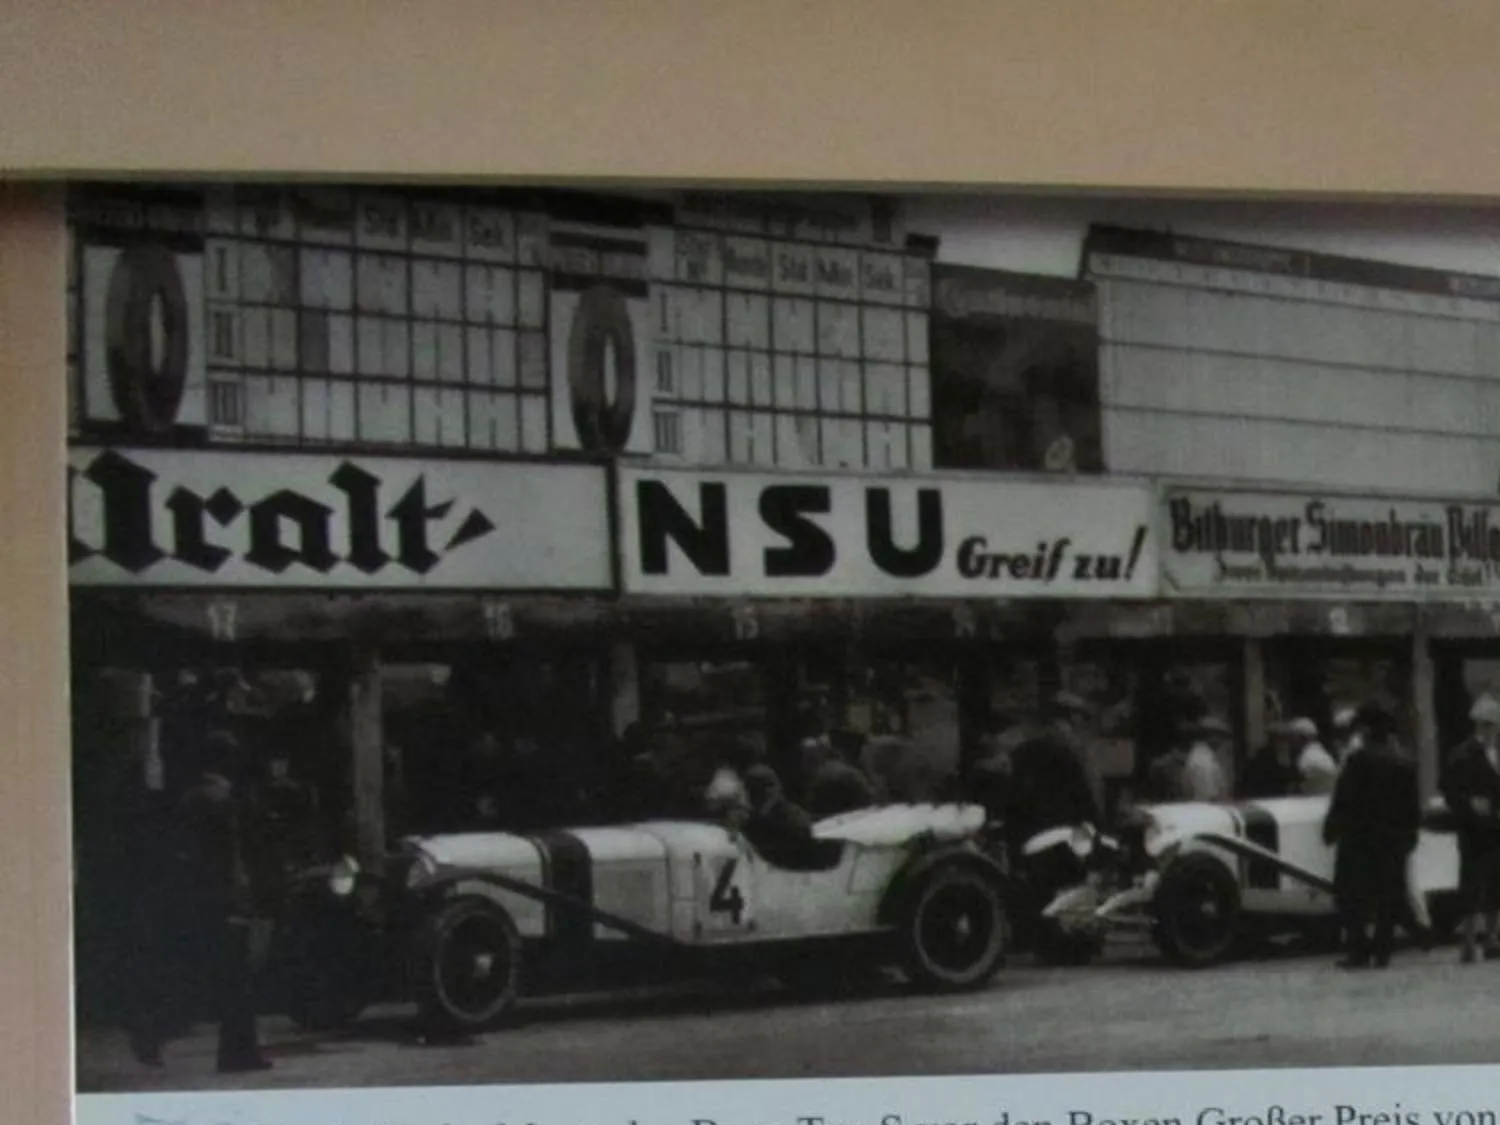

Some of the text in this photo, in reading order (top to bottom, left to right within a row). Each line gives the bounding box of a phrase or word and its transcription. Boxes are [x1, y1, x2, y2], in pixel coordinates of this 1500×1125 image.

[636, 479, 946, 577] NSU
[956, 525, 1148, 582] Greif zu!
[709, 860, 747, 925] 4
